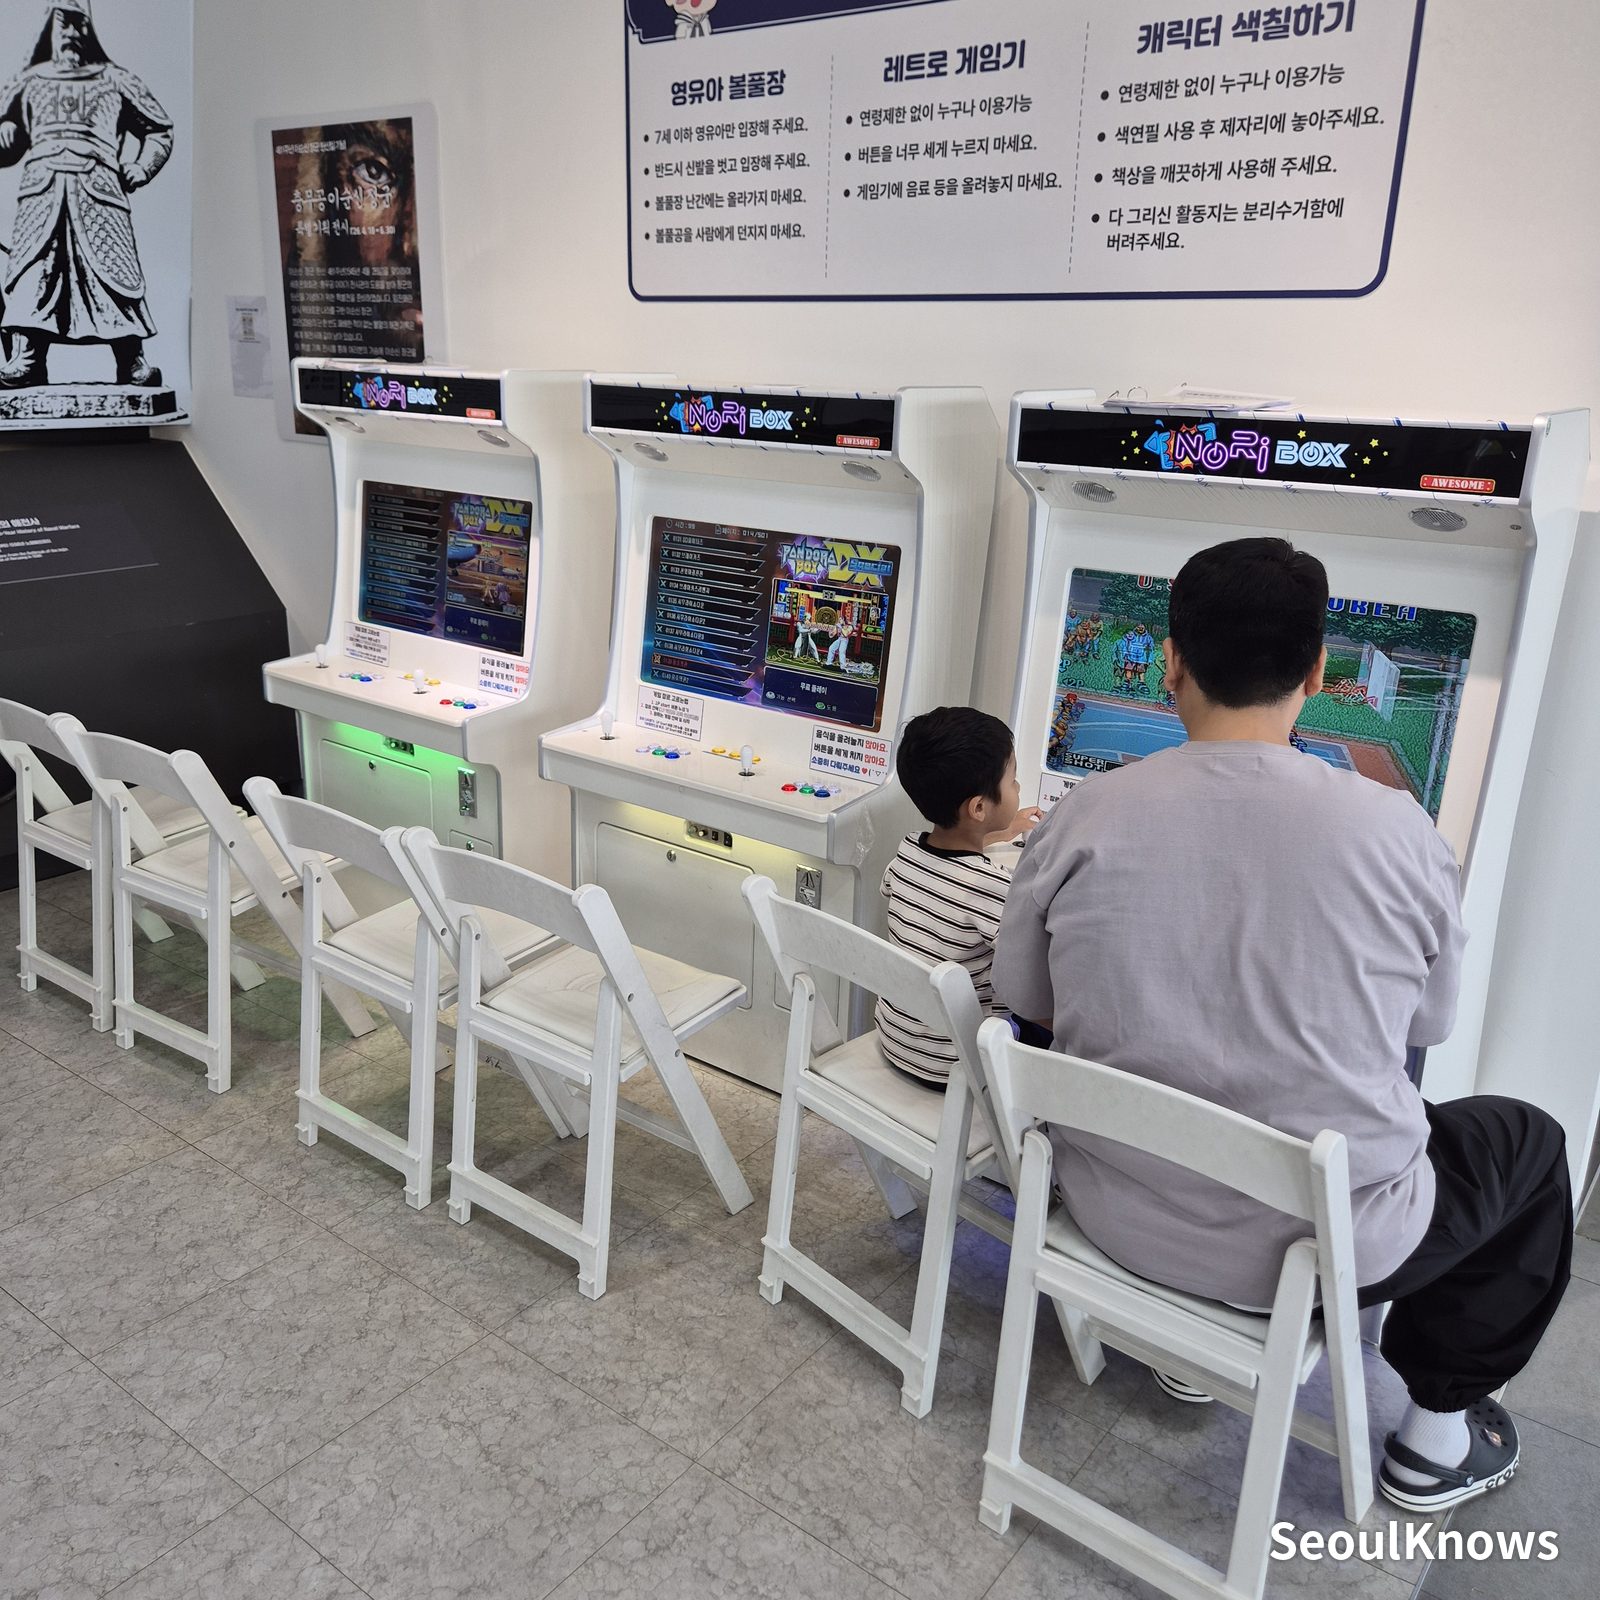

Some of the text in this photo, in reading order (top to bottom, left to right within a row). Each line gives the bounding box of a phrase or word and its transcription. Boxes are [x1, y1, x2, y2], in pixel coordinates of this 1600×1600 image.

[1137, 0, 1355, 54] 캐릭터 색칠하기
[884, 39, 1025, 82] 레트로 게임기
[671, 69, 786, 106] 영유아 볼풀장
[1119, 64, 1345, 103] 연령제한 없이 누구나 이용가능
[860, 95, 1032, 127] 연령제한 없이 누구나 이용가능
[655, 117, 808, 144] 7세 이하 영유아만 입장해 주세요.
[1115, 106, 1384, 144] 색연필 사용 후 제자리에 놓아주세요.
[859, 135, 1036, 163] 버튼을 너무 세게 누르지 마세요.
[655, 153, 810, 178] 반드시 신발을 벗고 입장해 주세요.
[1112, 155, 1336, 186] 책상을 깨끗하게 사용해 주세요.
[327, 187, 363, 210] 이순신
[857, 172, 1061, 200] 게임기에 음료 등을 올려놓지 마세요.
[656, 189, 806, 211] 볼풀장 난간에는 올라가지 마세요.
[1109, 198, 1344, 226] 다 그리신 활동지는 분리수거함에
[656, 223, 805, 243] 볼풀공을 사람에게 던지지 마세요.
[1107, 232, 1184, 251] 버려주세요.
[407, 387, 438, 406] BOX
[750, 409, 794, 430] BOX
[842, 438, 875, 447] AWESOME
[1275, 440, 1351, 469] BOX
[1431, 477, 1485, 490] AWESOME
[781, 538, 838, 576] PANDORA BOX
[823, 540, 886, 587] DX
[800, 682, 827, 695] 무료 플레이
[816, 730, 888, 752] 음식을 올려놓지 않아요.
[812, 756, 829, 767] 소중히
[814, 743, 887, 767] 버튼을 세게 치지 않아요.
[1064, 758, 1104, 770] SHOT
[1065, 752, 1104, 765] SUPER
